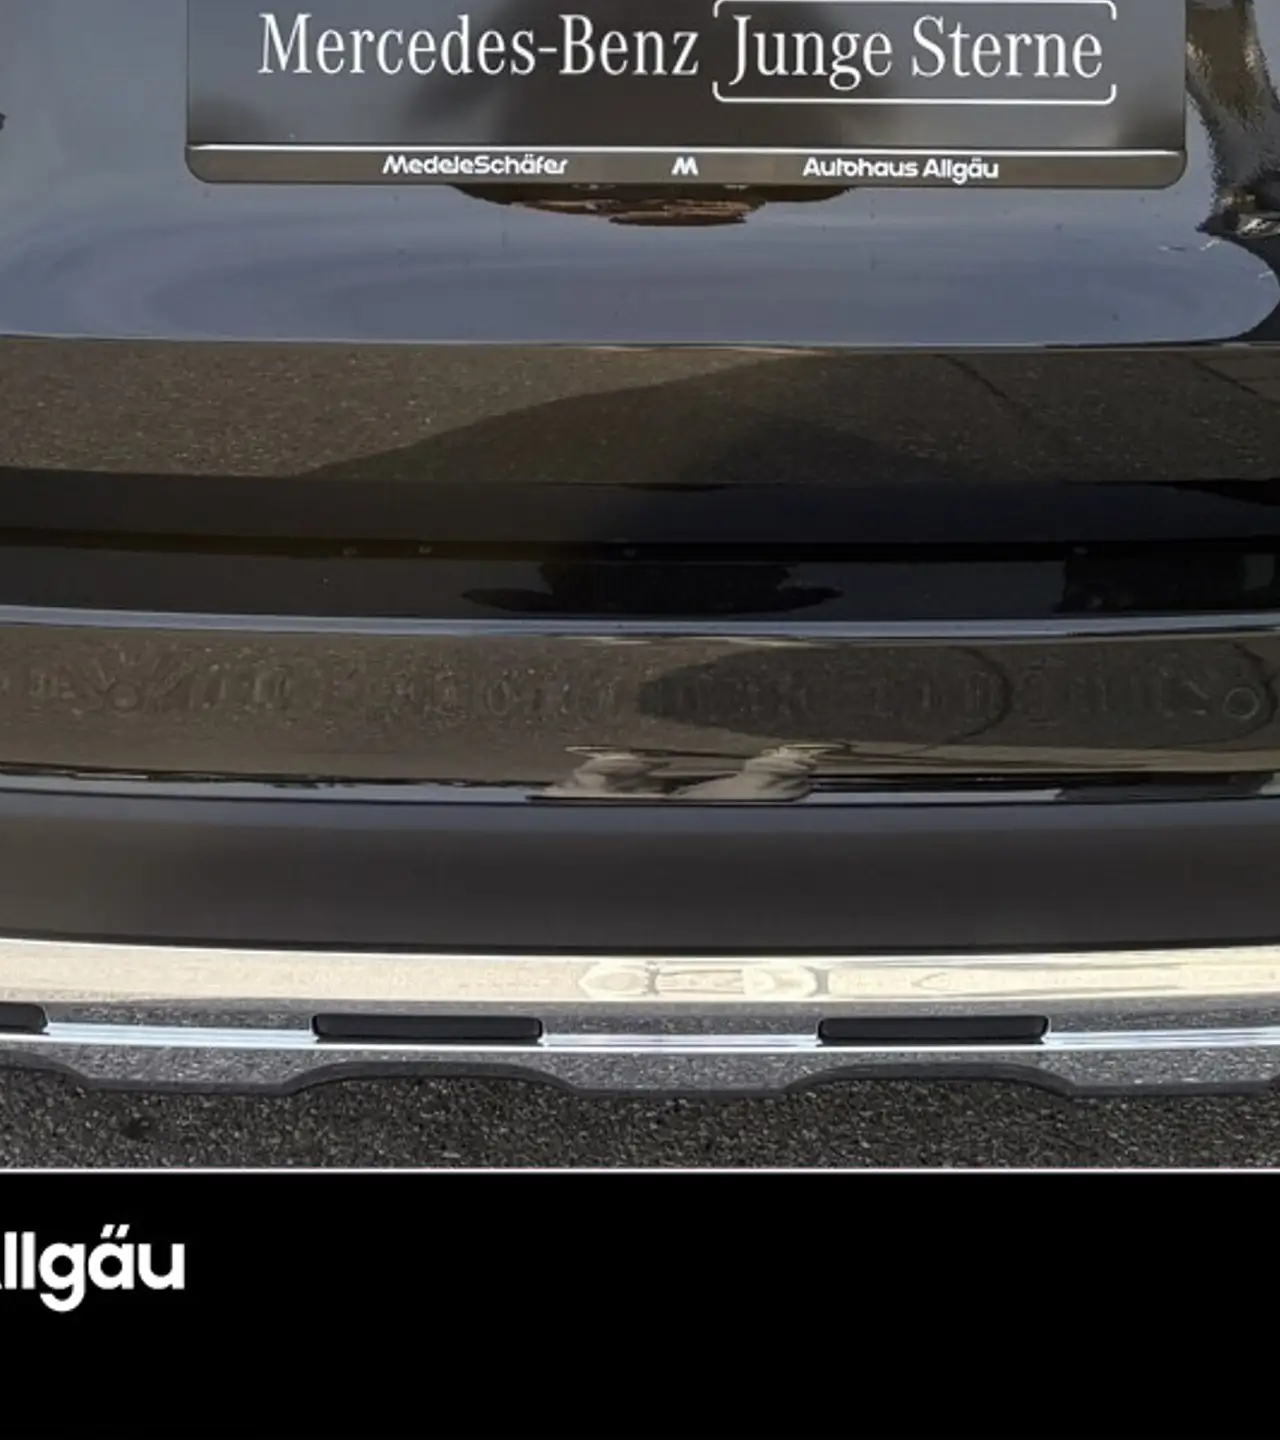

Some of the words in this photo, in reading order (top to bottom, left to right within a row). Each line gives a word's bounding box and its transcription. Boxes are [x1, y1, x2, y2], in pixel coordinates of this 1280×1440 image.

[258, 13, 699, 76] Mercedes-Benz
[729, 15, 893, 91] Junge
[911, 14, 1103, 79] Sterne
[382, 154, 569, 175] MedeleSchäfer
[802, 156, 919, 178] Autohaus
[922, 156, 999, 184] Allgäu
